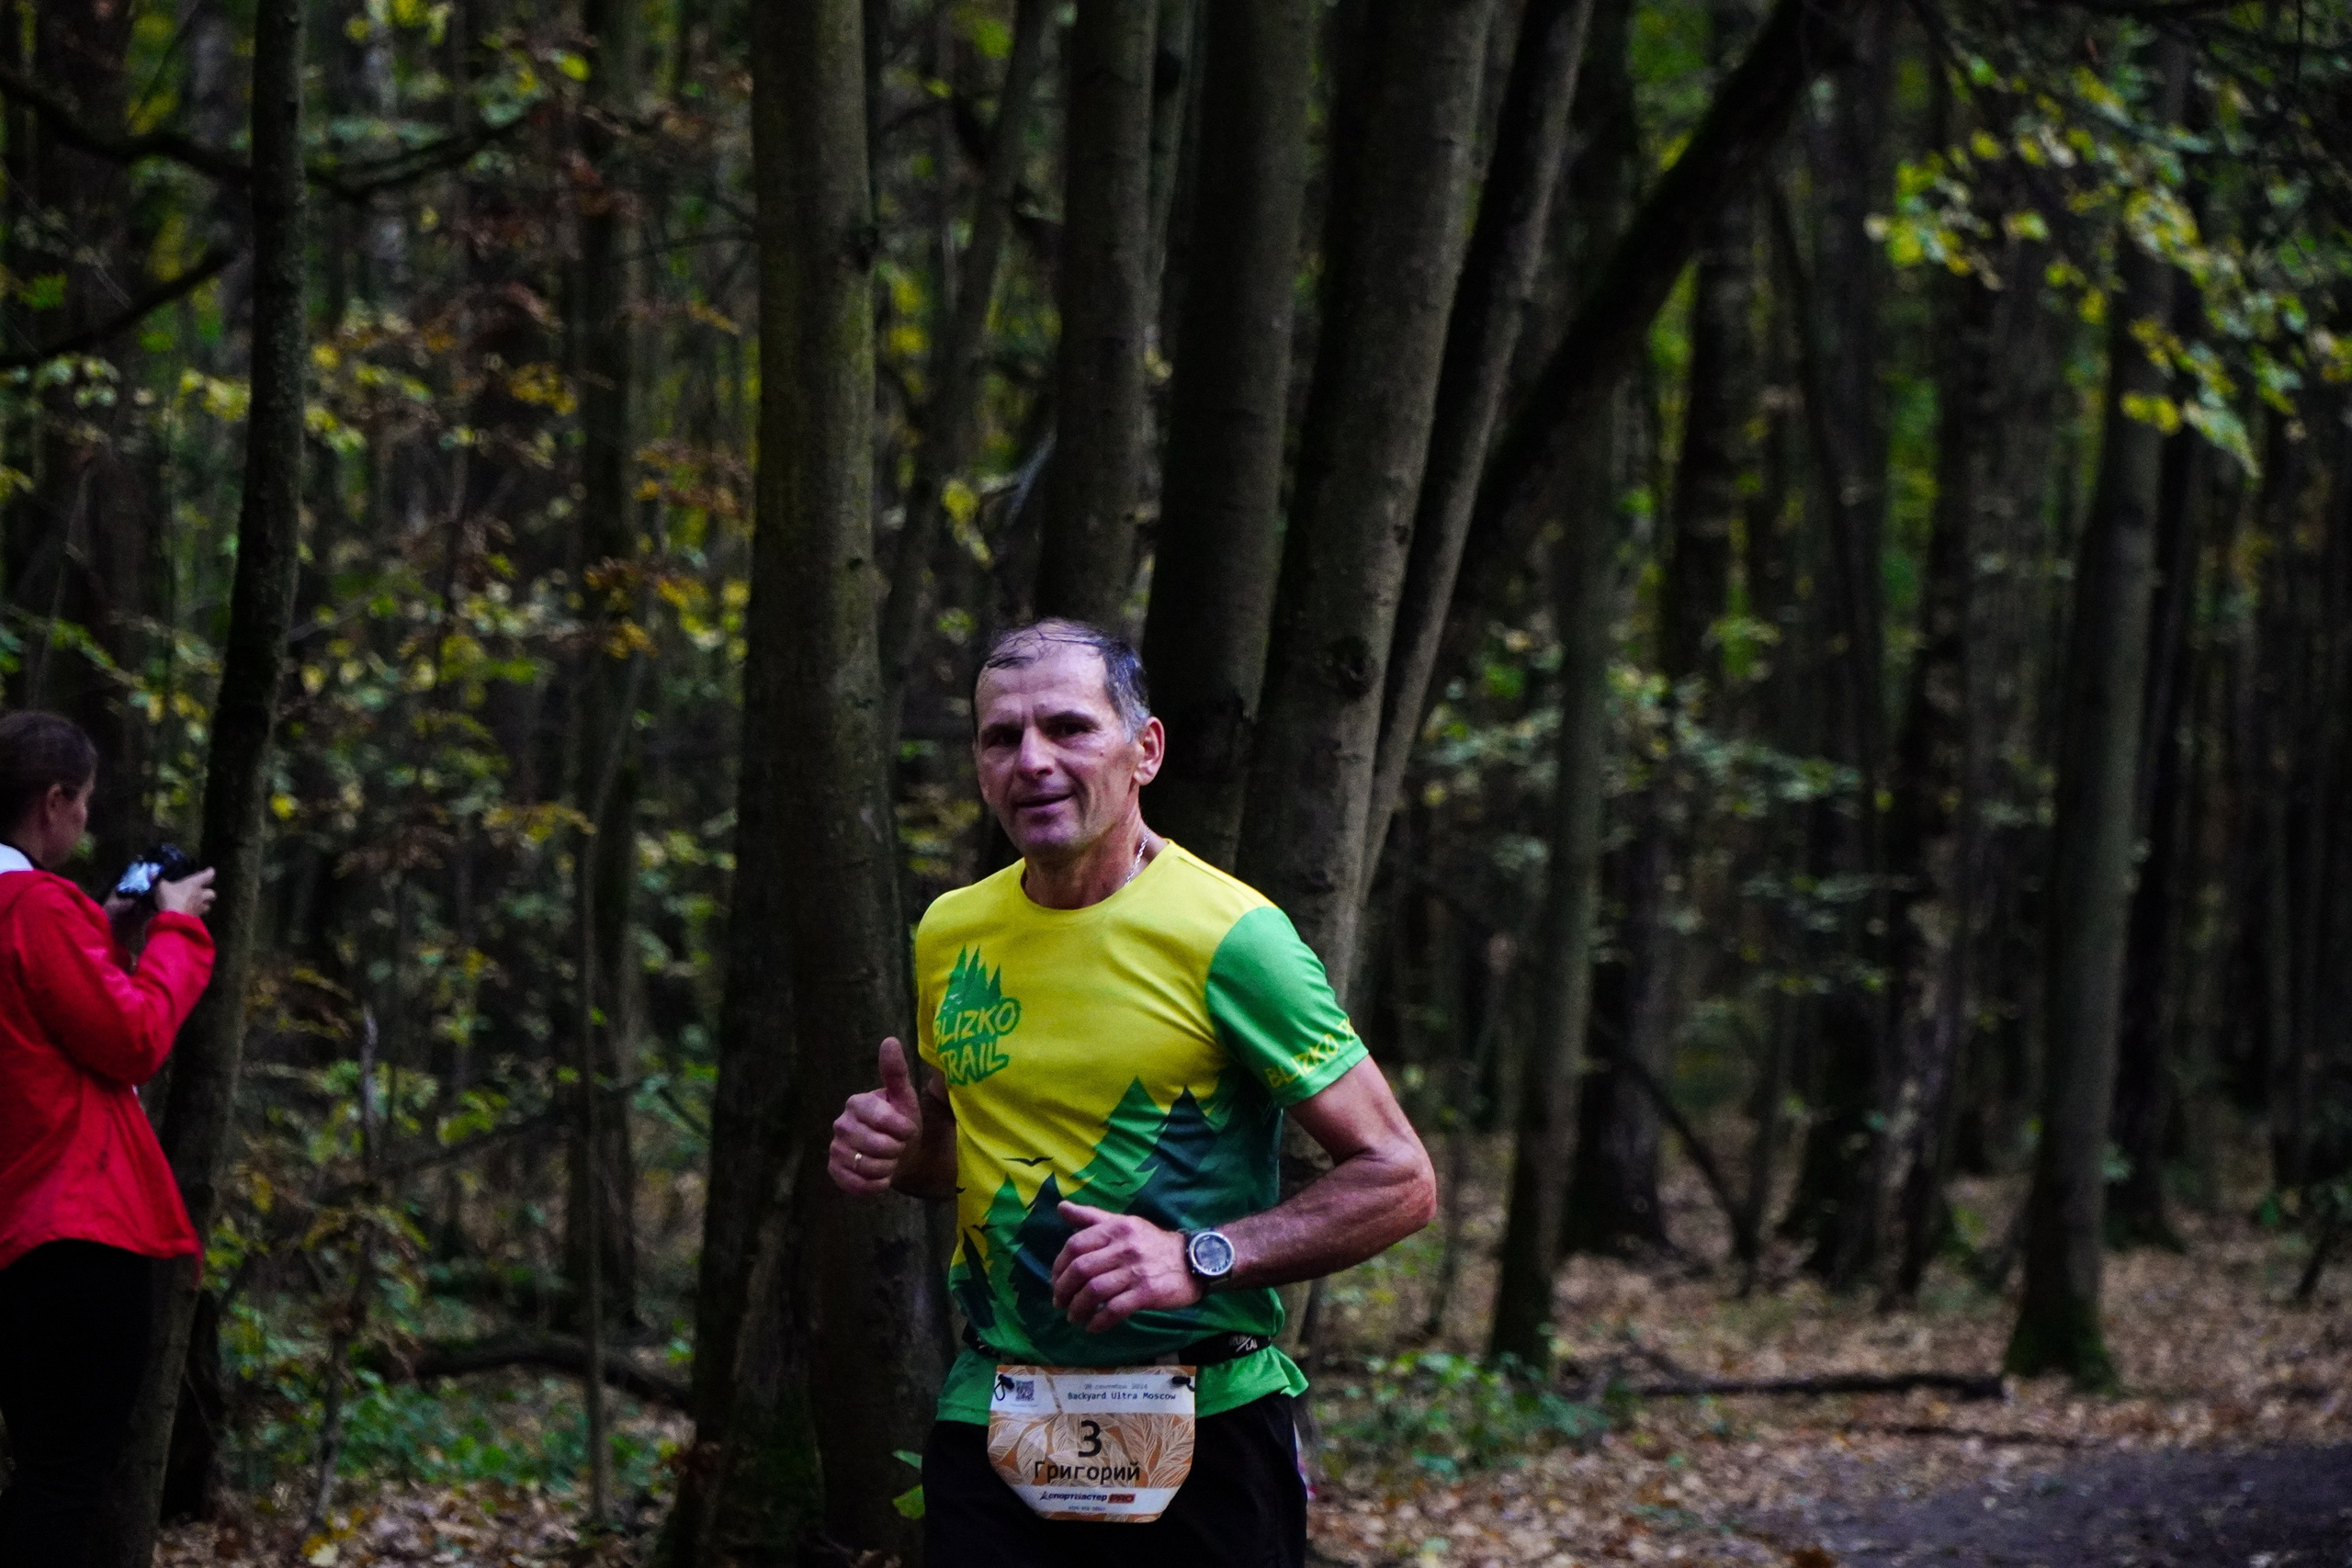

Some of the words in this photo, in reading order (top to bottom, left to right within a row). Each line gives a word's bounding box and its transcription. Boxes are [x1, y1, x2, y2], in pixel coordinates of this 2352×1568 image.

[1068, 1392, 1106, 1401] Backyard
[1111, 1392, 1138, 1400] Ultra
[1142, 1392, 1176, 1401] Moscow
[1078, 1419, 1102, 1458] 3
[1035, 1461, 1140, 1484] Григорий
